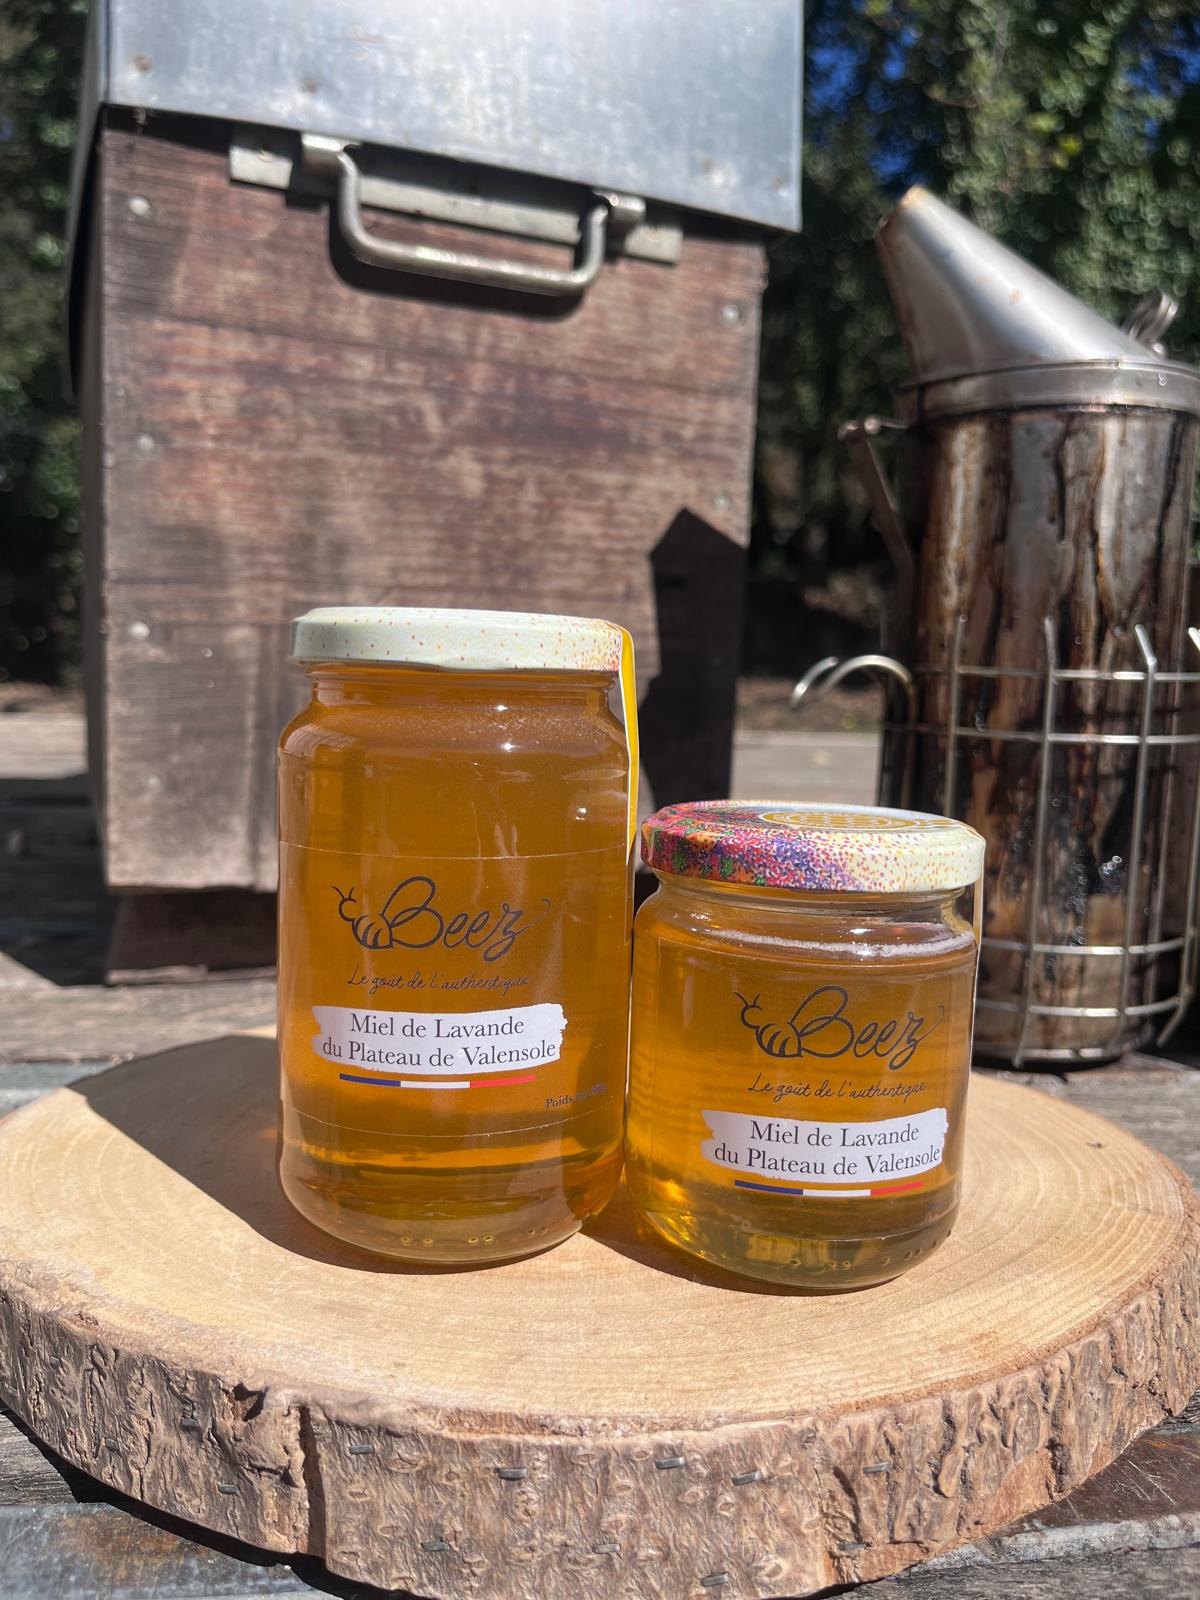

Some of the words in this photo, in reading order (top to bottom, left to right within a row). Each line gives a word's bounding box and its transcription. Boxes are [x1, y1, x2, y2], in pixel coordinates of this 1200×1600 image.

[347, 965, 368, 986] Le
[407, 969, 426, 989] de
[429, 970, 529, 996] l'authentique
[350, 1013, 394, 1036] Miel
[402, 1015, 426, 1038] de
[434, 1015, 525, 1039] Lavande
[322, 1036, 342, 1057] du
[348, 1040, 421, 1066] Plateau
[429, 1044, 454, 1067] de
[462, 1040, 556, 1065] Valensole
[545, 1095, 574, 1109] Poids
[748, 1072, 773, 1093] Le
[815, 1079, 834, 1097] de
[838, 1080, 926, 1103] l'authentique
[750, 1120, 799, 1145] Miel
[807, 1127, 832, 1147] de
[839, 1123, 919, 1148] Lavande
[714, 1142, 738, 1164] du
[746, 1147, 825, 1175] Plateau
[833, 1156, 857, 1175] de
[865, 1144, 941, 1174] Valensole
